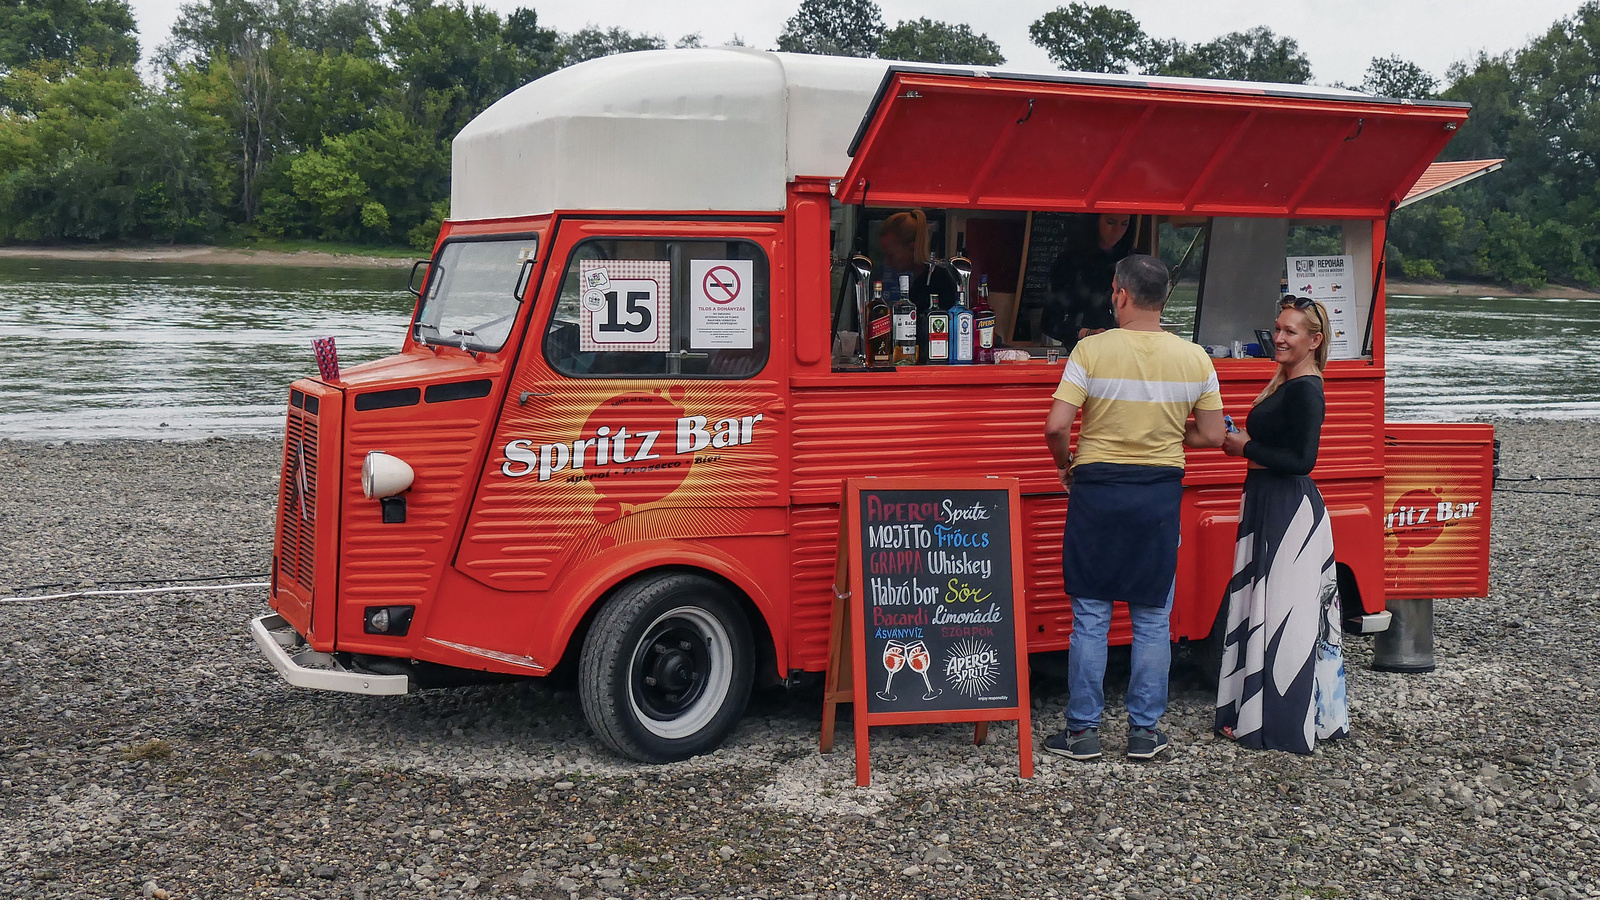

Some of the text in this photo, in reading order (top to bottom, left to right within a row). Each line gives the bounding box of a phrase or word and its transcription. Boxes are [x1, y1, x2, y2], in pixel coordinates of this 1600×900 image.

[1317, 258, 1344, 268] REPOHÁR
[598, 291, 652, 333] 15
[501, 413, 764, 482] Spritz Bar
[566, 455, 722, 485] Aperol Prosecco Bier
[867, 494, 991, 525] APEROL Spritz
[1384, 501, 1480, 529] ritz Bar
[870, 550, 992, 579] GRAPPA Whiskey
[870, 577, 993, 606] Habzó bor Sör
[873, 602, 1003, 627] Bacardi Limonádé
[874, 626, 924, 639] ÁSVÁNYVÍZ
[946, 649, 998, 676] APEROL
